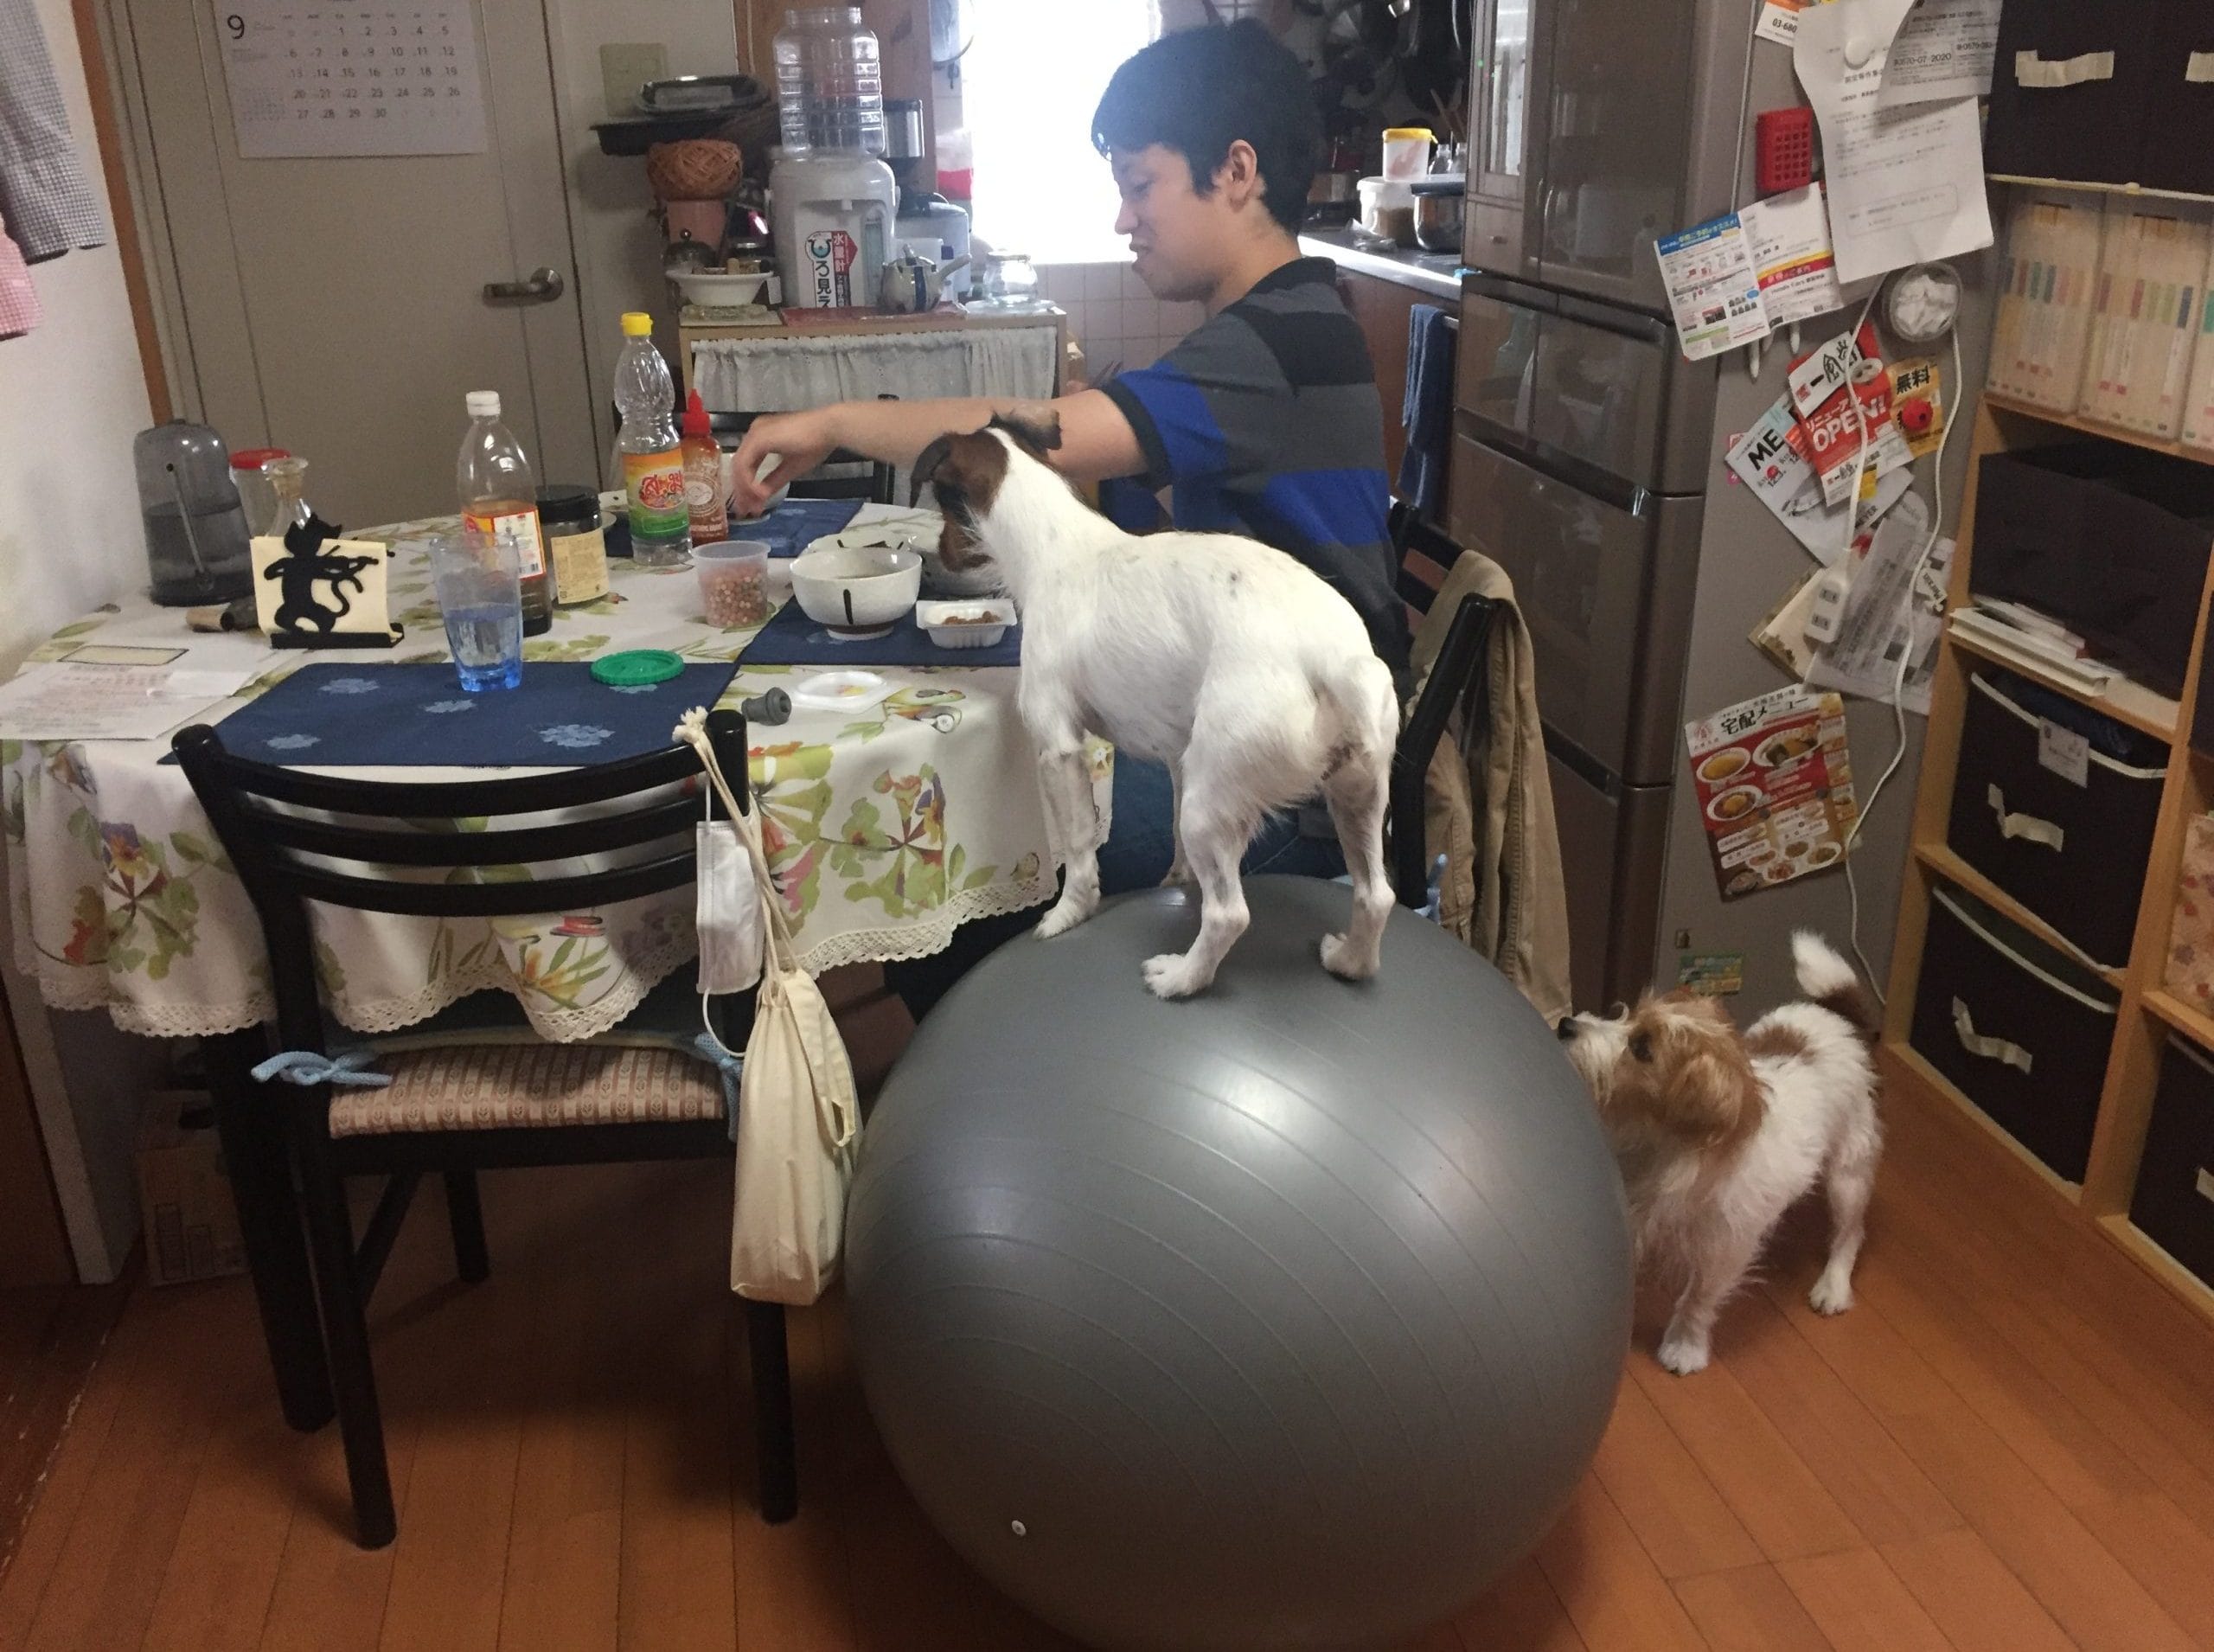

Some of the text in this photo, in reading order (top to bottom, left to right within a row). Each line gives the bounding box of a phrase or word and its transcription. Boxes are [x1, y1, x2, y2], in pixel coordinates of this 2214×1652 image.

[227, 15, 245, 40] 9
[366, 27, 371, 35] 2
[391, 27, 397, 35] 3
[1930, 53, 1952, 62] 2020
[343, 68, 355, 77] 15
[369, 68, 380, 77] 16
[394, 67, 406, 76] 17
[420, 67, 431, 76] 18
[445, 67, 457, 75] 19
[294, 87, 460, 99] 20 21 22 23 24 25 26
[298, 111, 308, 119] 27
[323, 110, 335, 118] 28
[374, 109, 386, 118] 30
[1897, 366, 1930, 394] 無料
[1721, 697, 1809, 735] 宅配メニュー
